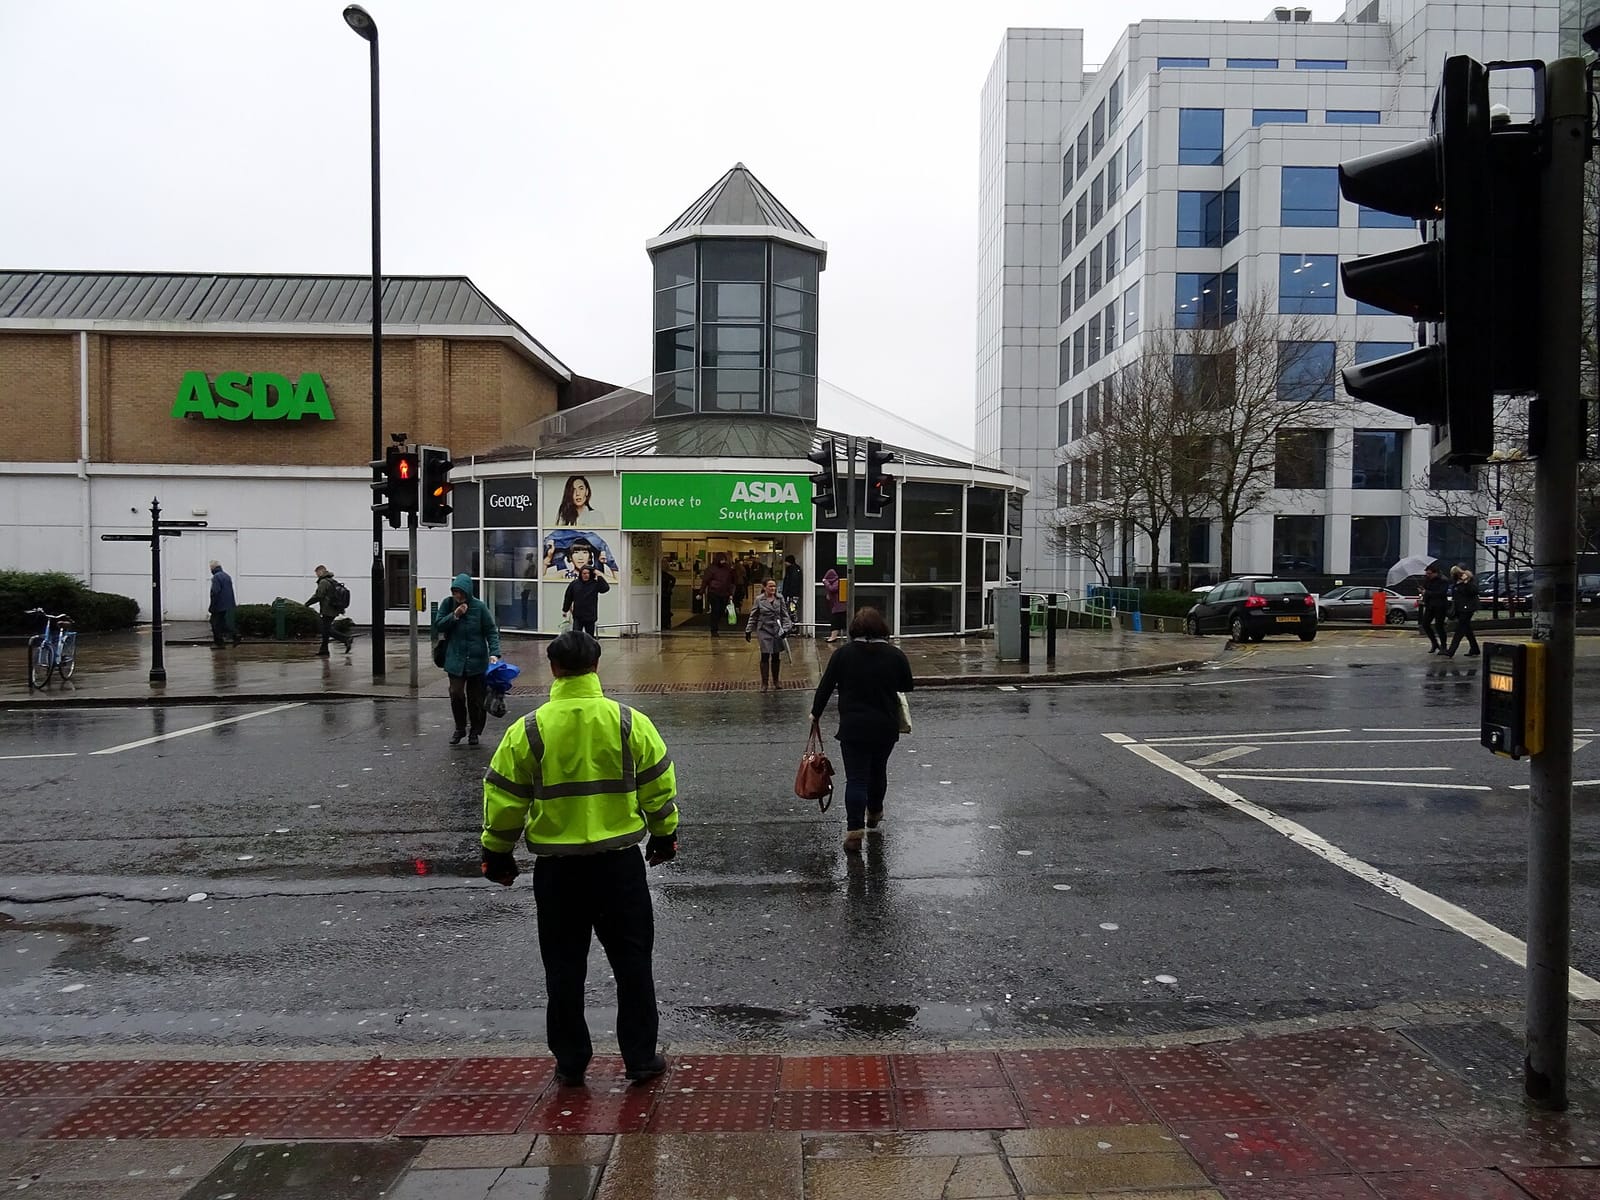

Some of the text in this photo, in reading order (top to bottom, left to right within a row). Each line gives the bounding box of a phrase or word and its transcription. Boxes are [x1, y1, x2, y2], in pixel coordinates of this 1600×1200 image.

[170, 370, 336, 421] ASDA
[730, 481, 800, 504] ASDA
[490, 494, 532, 511] George.
[629, 495, 702, 508] Welcome to
[719, 507, 804, 523] Southampton
